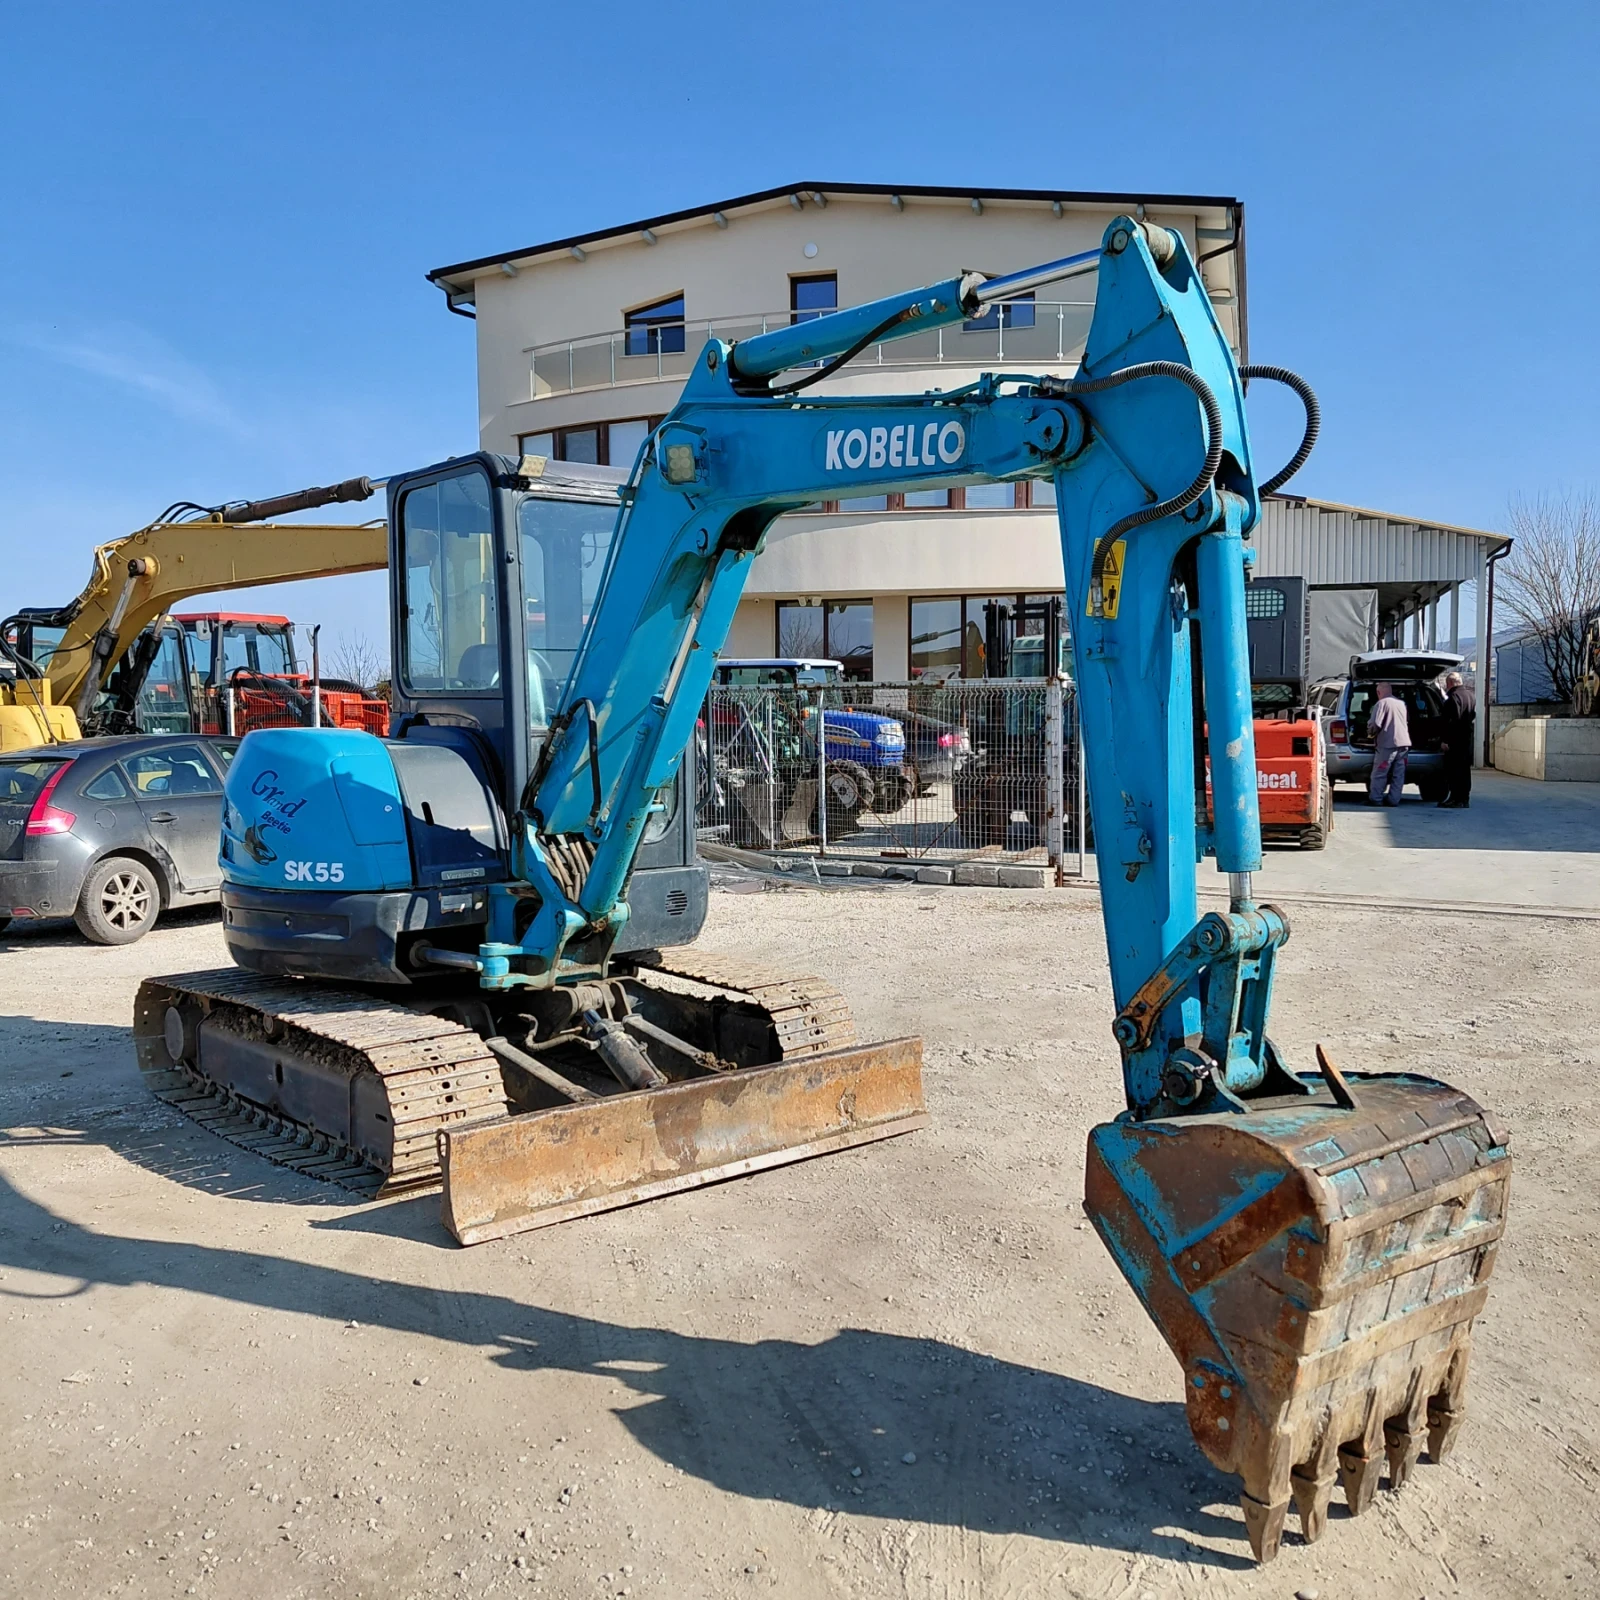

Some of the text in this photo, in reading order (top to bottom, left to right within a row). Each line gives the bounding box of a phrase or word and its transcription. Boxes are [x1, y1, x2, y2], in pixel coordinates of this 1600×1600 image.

[825, 420, 966, 470] KOBELCO
[1257, 770, 1297, 788] bcat
[284, 860, 345, 882] SK55
[446, 868, 480, 880] Version S
